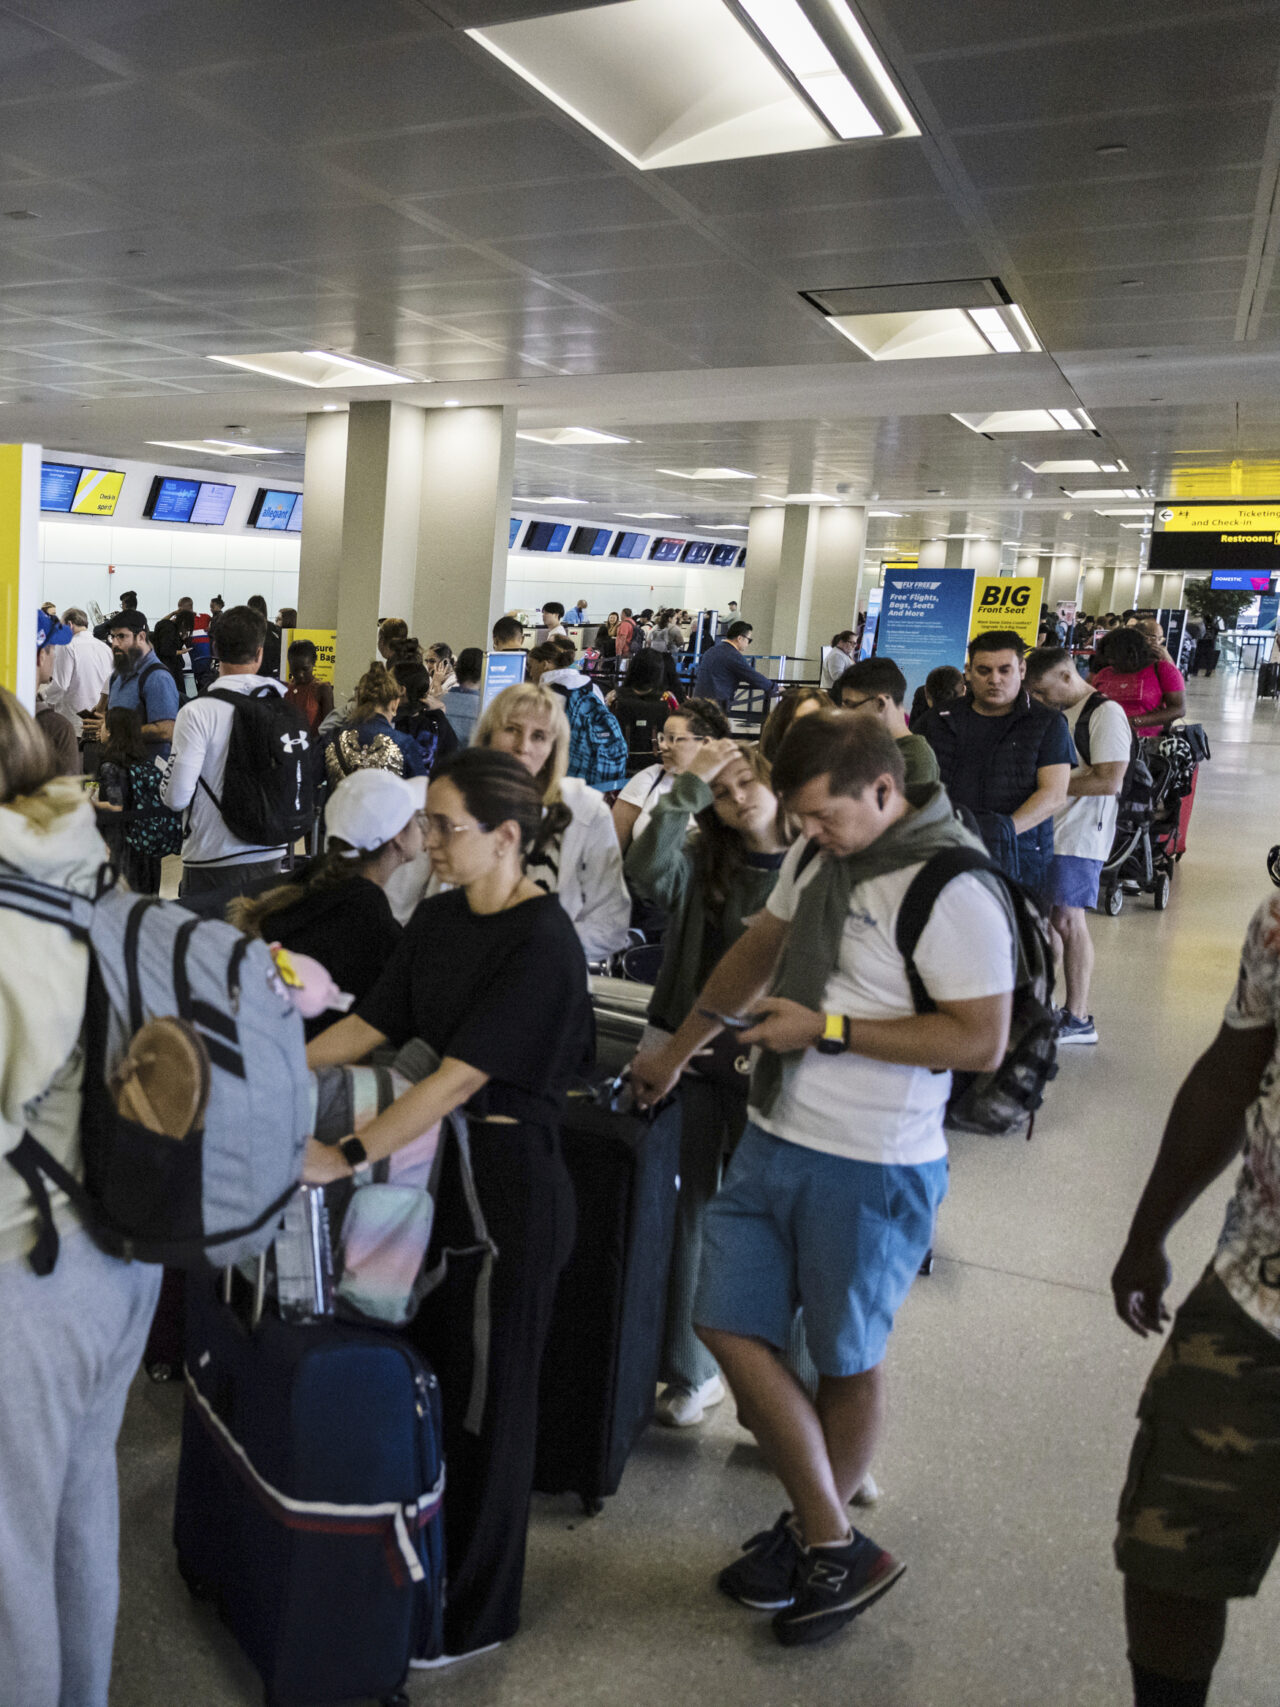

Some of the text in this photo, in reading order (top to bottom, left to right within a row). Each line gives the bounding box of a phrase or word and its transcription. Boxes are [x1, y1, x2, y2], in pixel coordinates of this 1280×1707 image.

[262, 507, 288, 520] allegiant
[1238, 510, 1280, 518] Ticketing
[1221, 534, 1273, 543] Restrooms
[910, 593, 939, 602] Flights,
[980, 585, 1031, 606] BIG
[889, 601, 910, 609] Bags,
[1004, 606, 1026, 614] Seat
[320, 653, 336, 664] Bag
